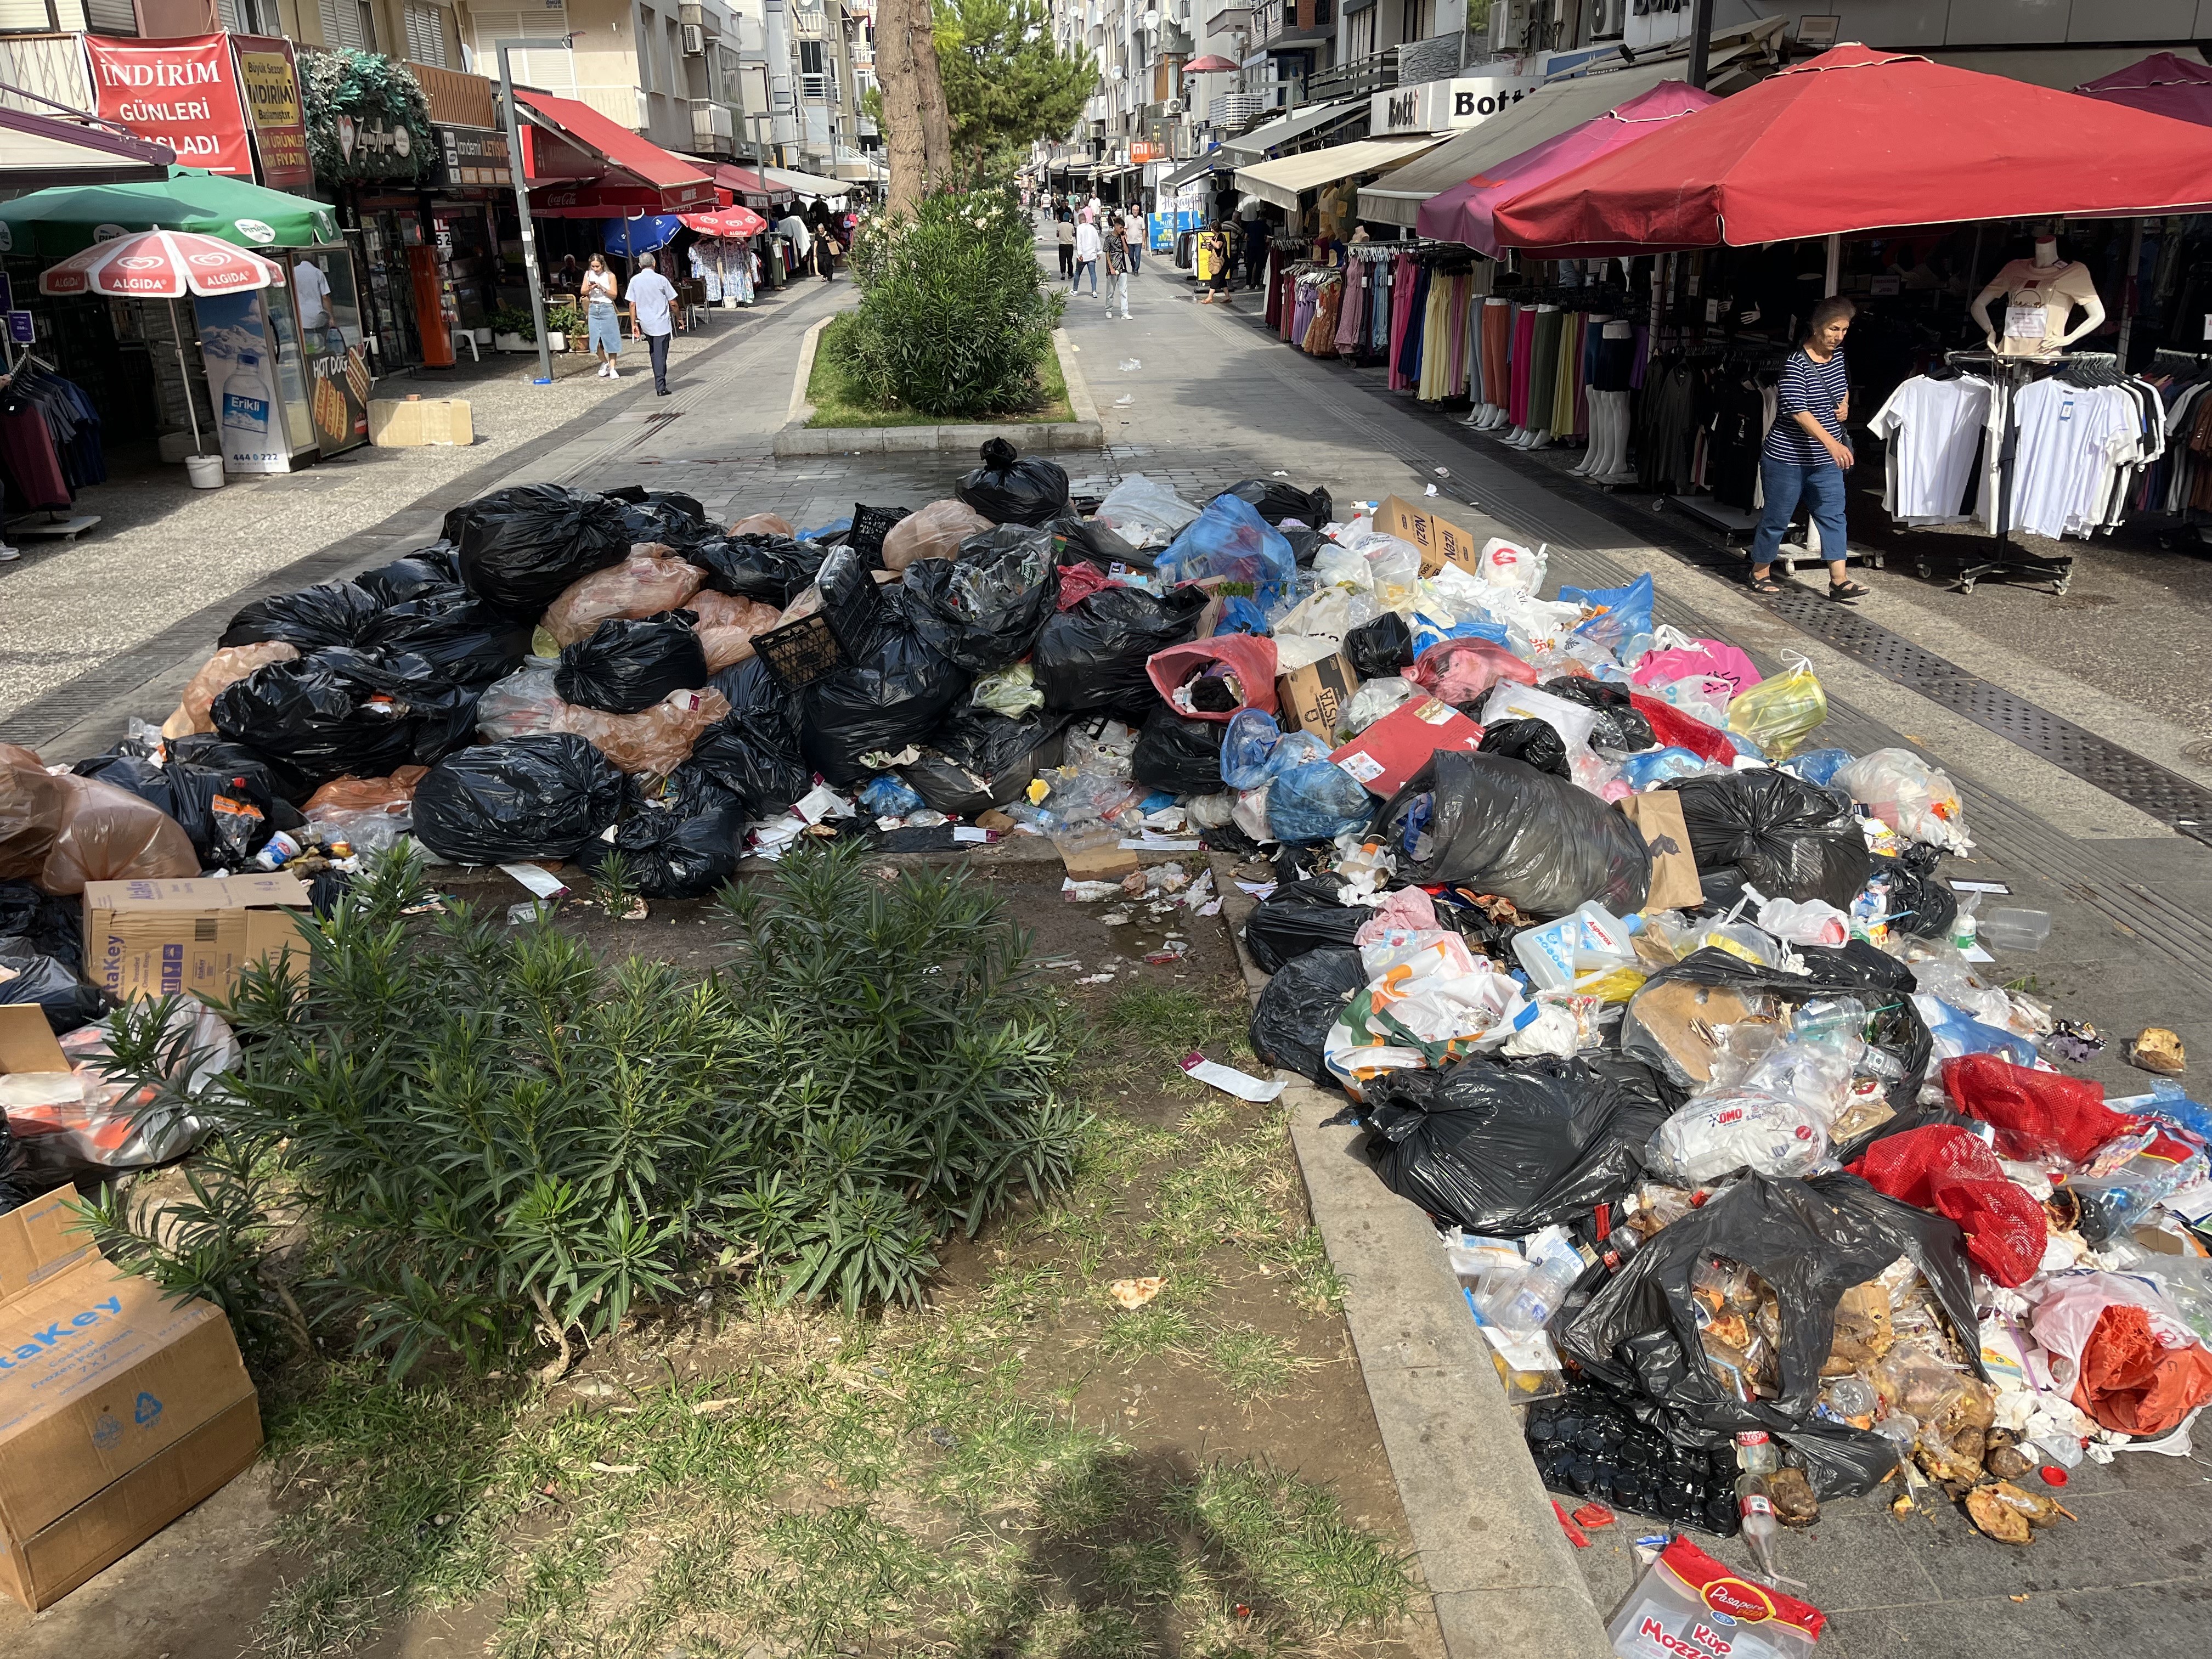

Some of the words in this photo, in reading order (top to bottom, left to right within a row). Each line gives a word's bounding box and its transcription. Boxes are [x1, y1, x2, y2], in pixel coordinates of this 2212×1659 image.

[100, 58, 222, 86] İNDİRİM
[247, 61, 266, 76] Büyük
[267, 63, 284, 75] Sezon
[247, 79, 296, 104] İNDİRİMİ
[1454, 87, 1536, 116] Bott
[119, 97, 211, 121] GÜNLERİ
[1387, 88, 1419, 127] Botti
[313, 357, 329, 379] HOT
[330, 356, 348, 376] DOG
[231, 396, 260, 412] Erikli
[261, 453, 278, 461] 222
[1420, 563, 1432, 574] 200
[1587, 921, 1612, 946] Asperox
[103, 935, 126, 996] taKey
[1719, 1108, 1742, 1124] OMO
[31, 1362, 76, 1390] Frozen
[77, 1329, 134, 1363] Potatoes
[49, 1340, 95, 1368] Coated
